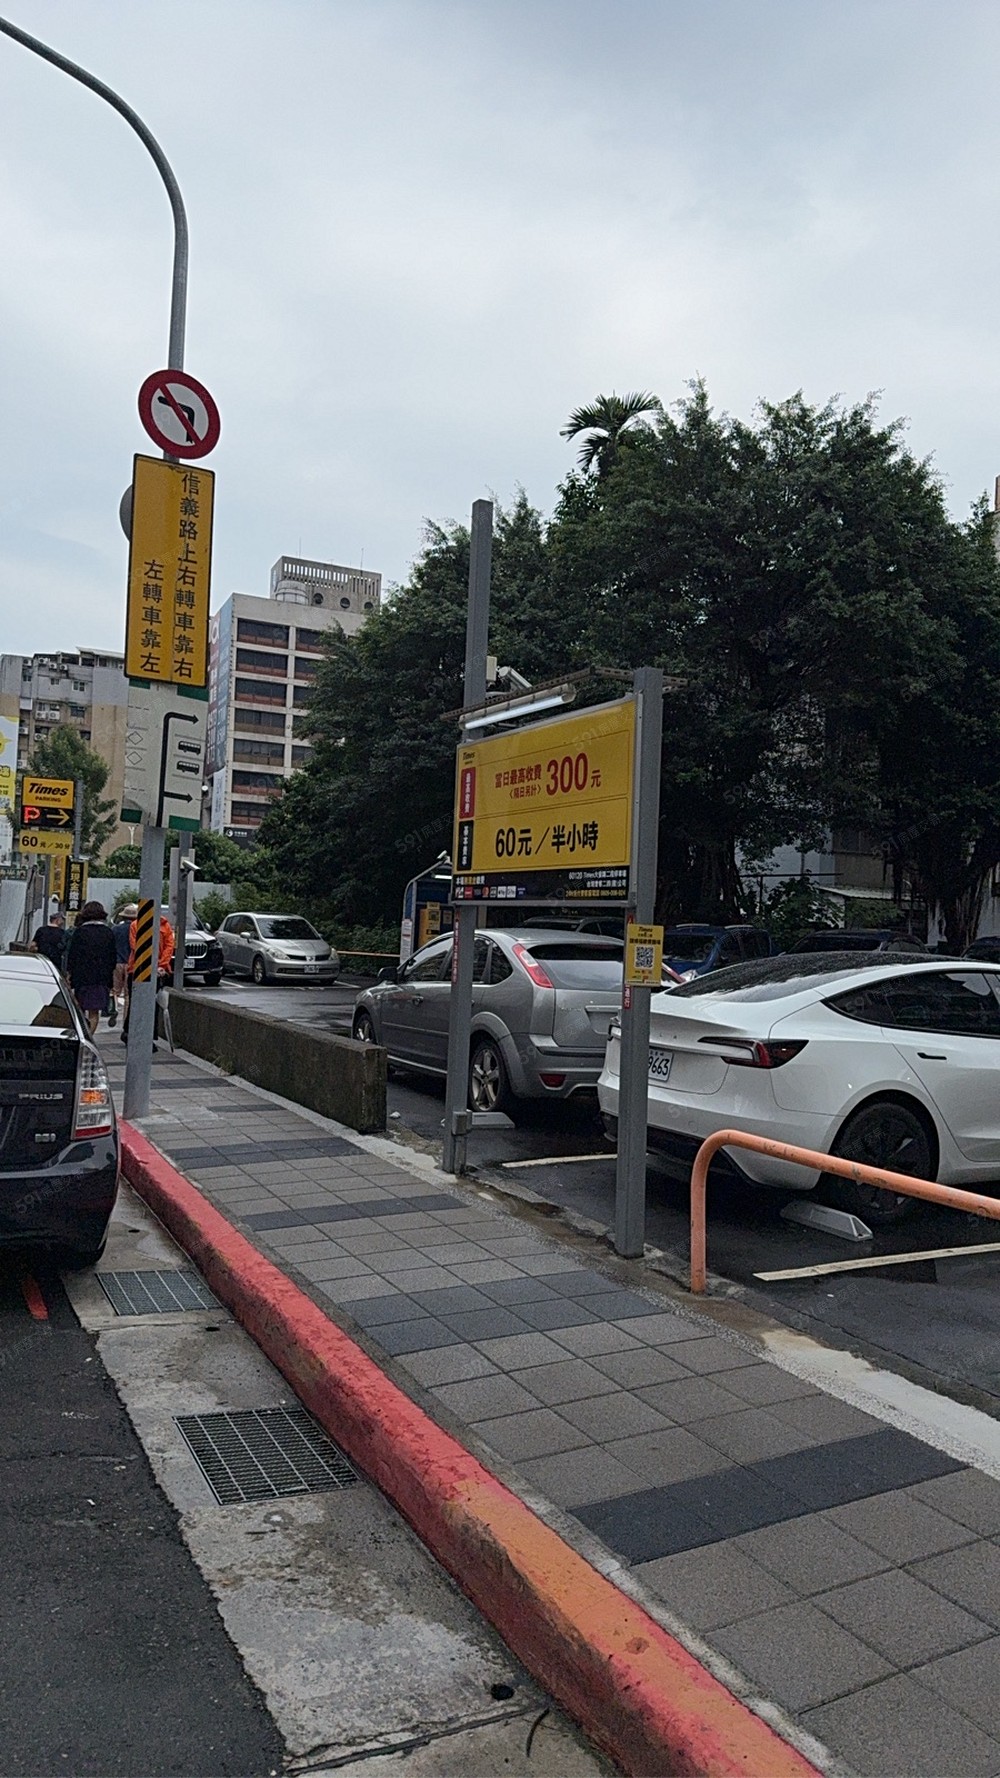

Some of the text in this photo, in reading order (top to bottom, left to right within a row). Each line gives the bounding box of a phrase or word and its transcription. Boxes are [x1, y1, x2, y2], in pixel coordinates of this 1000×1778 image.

[173, 472, 201, 678] 信義路上右轉車靠右
[140, 559, 165, 674] 左轉車靠左
[495, 752, 602, 796] 當日最高收費 300 元
[28, 782, 69, 797] Times
[35, 796, 62, 804] PARKING
[24, 806, 40, 823] P
